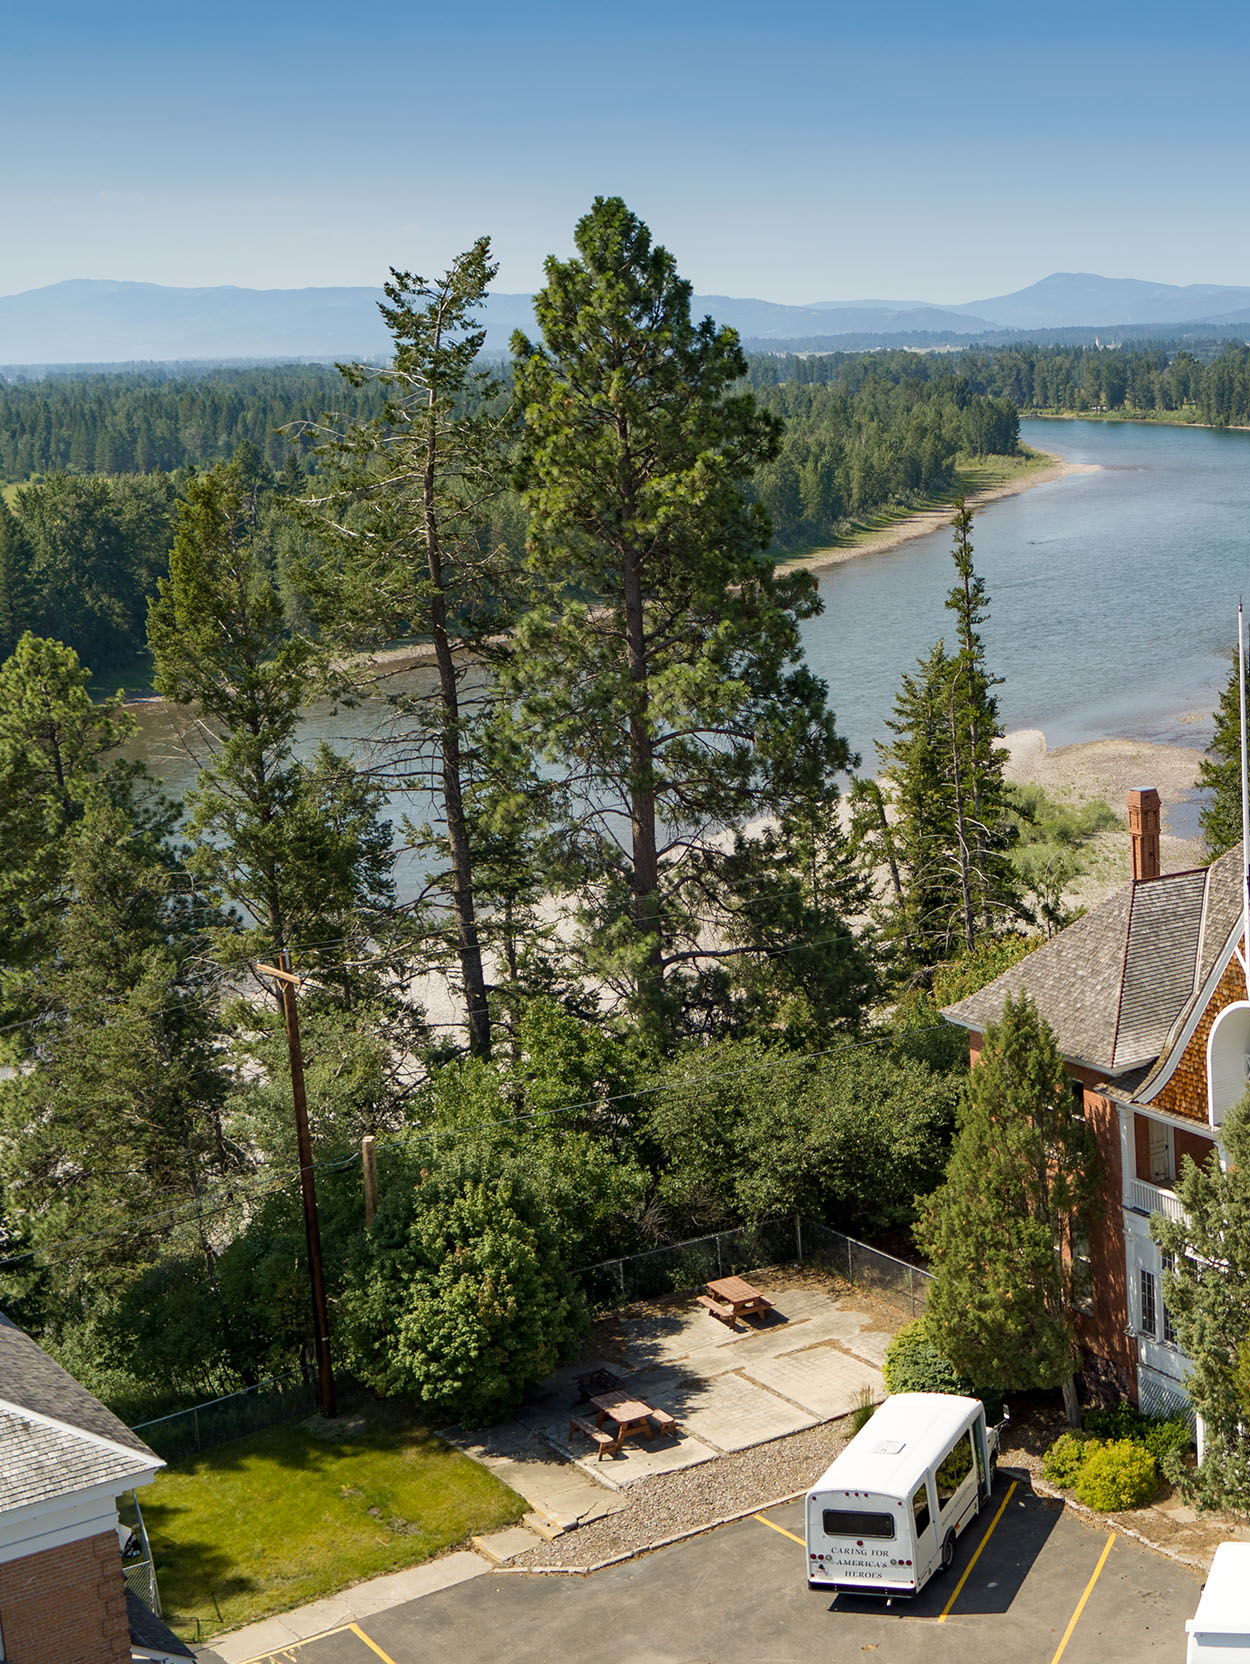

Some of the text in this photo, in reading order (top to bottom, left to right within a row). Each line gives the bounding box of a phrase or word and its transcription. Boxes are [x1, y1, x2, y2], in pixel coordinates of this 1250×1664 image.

[831, 1547, 889, 1557] CARING FOR
[837, 1559, 888, 1568] AMERICA'S
[845, 1571, 882, 1579] HEROES
